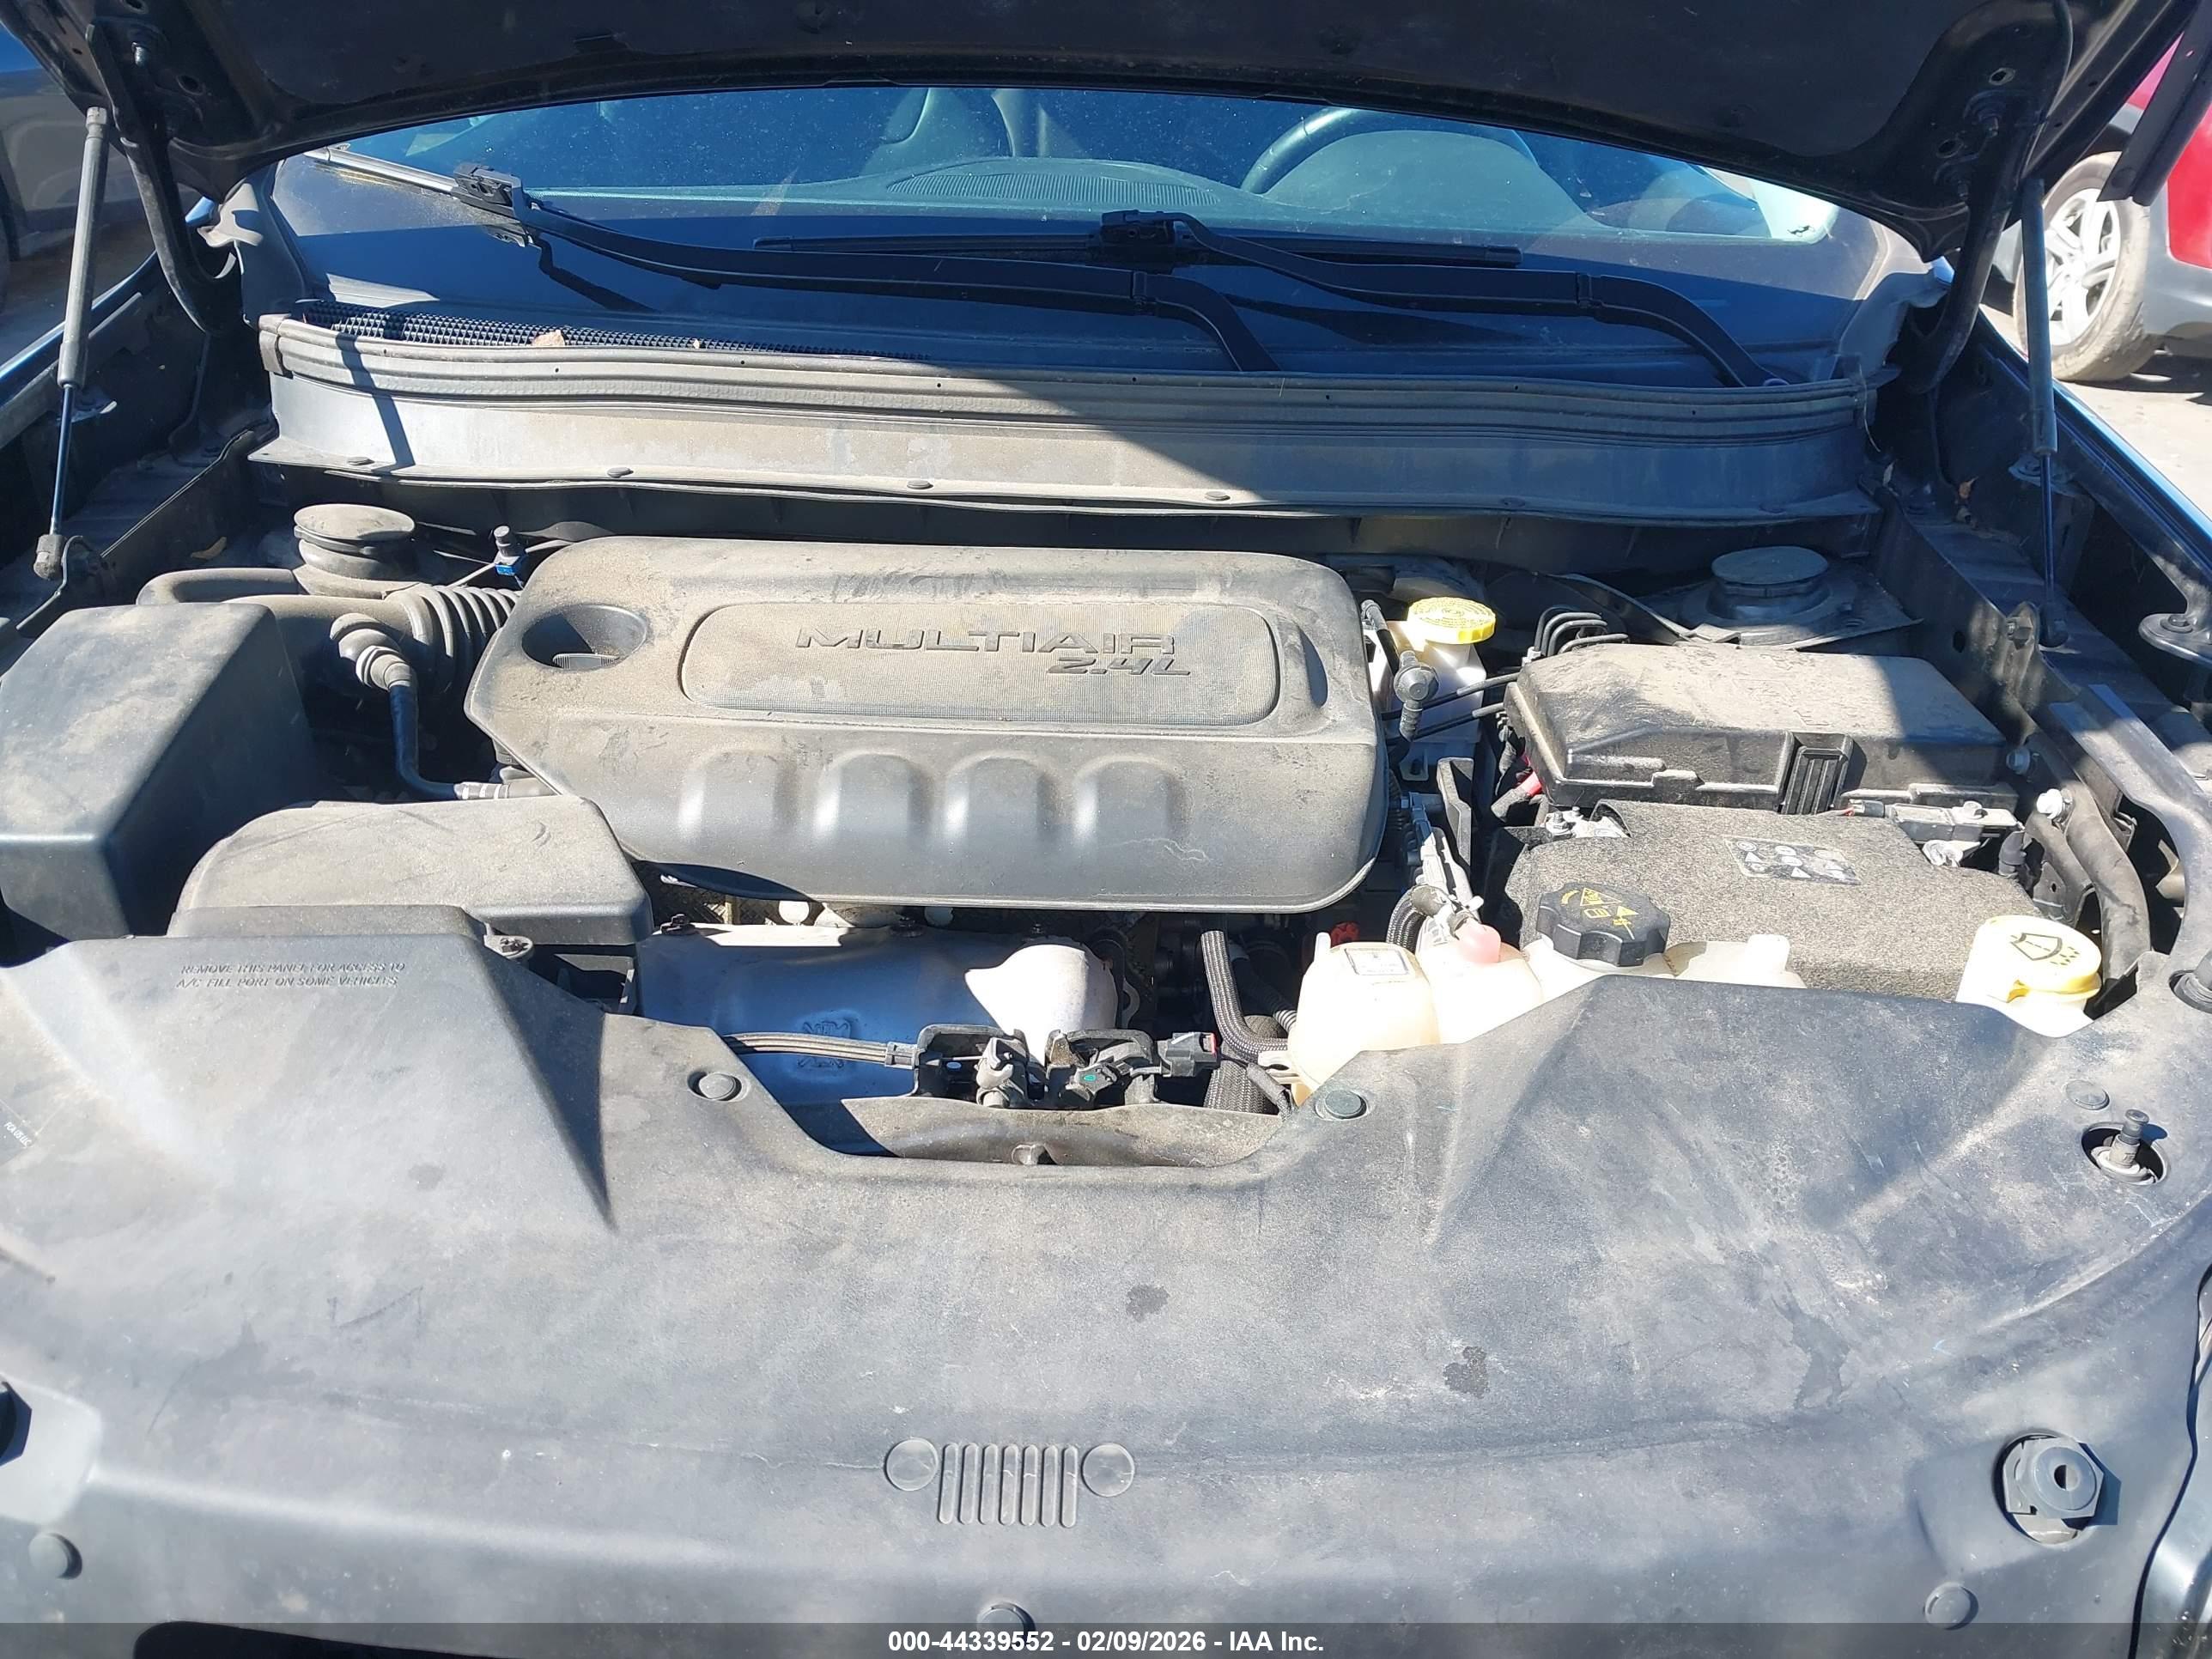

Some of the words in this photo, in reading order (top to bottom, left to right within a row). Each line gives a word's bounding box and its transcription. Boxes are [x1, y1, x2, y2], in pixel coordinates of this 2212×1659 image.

[795, 628, 1176, 655] MULTIAIR
[1047, 656, 1191, 676] 2.4L
[180, 963, 233, 975] REMOVE
[237, 963, 264, 974] THIS
[267, 963, 305, 974] PANEL
[309, 963, 335, 973] FOR
[338, 962, 386, 972] ACCESS
[390, 962, 405, 972] TO
[176, 977, 202, 988] A/C
[206, 977, 232, 988] FILL
[237, 977, 271, 987] PORT
[275, 976, 295, 987] ON
[296, 975, 335, 987] SOME
[338, 975, 399, 987] VEHICLES
